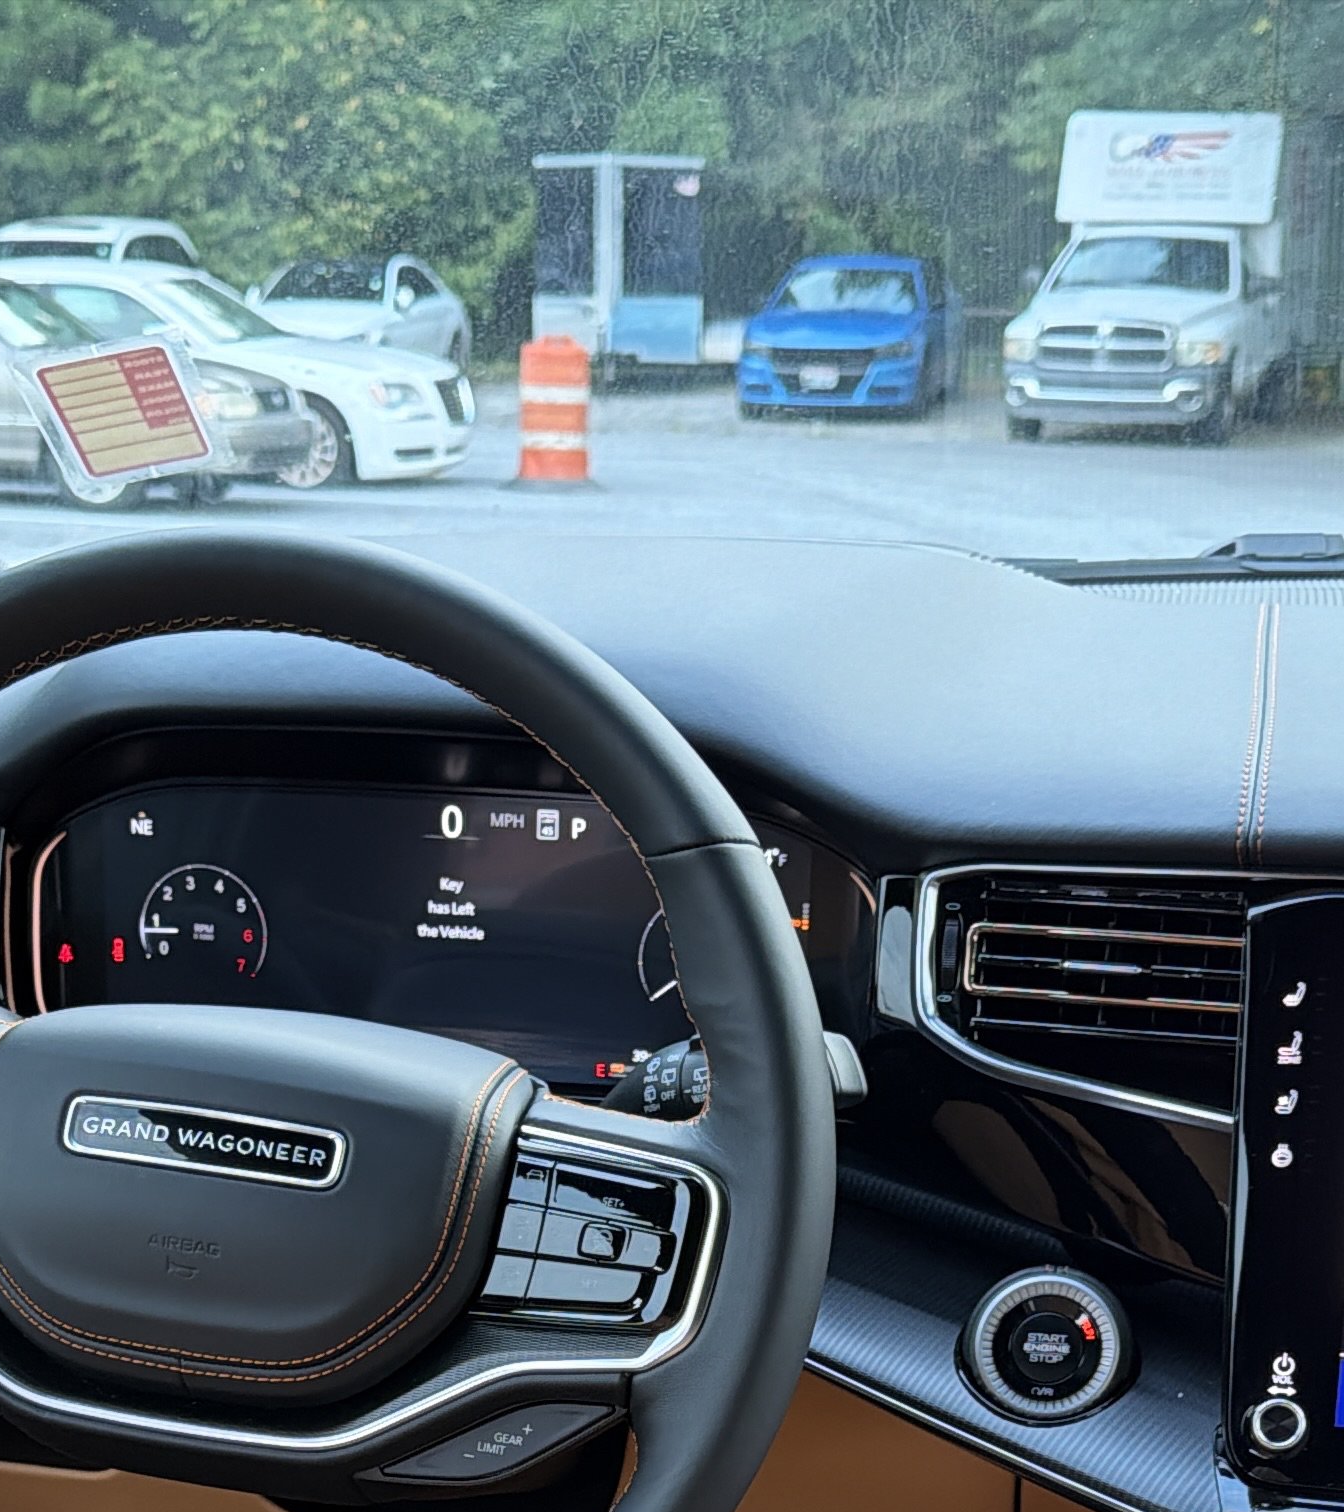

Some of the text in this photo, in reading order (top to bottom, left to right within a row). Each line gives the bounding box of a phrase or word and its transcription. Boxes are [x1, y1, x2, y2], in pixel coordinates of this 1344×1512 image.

[130, 818, 154, 836] NE
[441, 804, 463, 839] 0
[490, 812, 525, 829] MPH
[571, 817, 587, 839] P
[439, 877, 465, 894] Key
[427, 900, 476, 917] has Left
[417, 923, 485, 941] the Vehicle
[595, 1063, 606, 1078] E
[660, 1089, 677, 1101] OFF
[82, 1116, 327, 1167] GRAND WAGONEER
[147, 1232, 221, 1259] AIRBAG
[1027, 1332, 1069, 1343] START
[1028, 1353, 1065, 1364] STOP
[493, 1431, 523, 1447] GEAR
[477, 1441, 506, 1456] LIMIT
